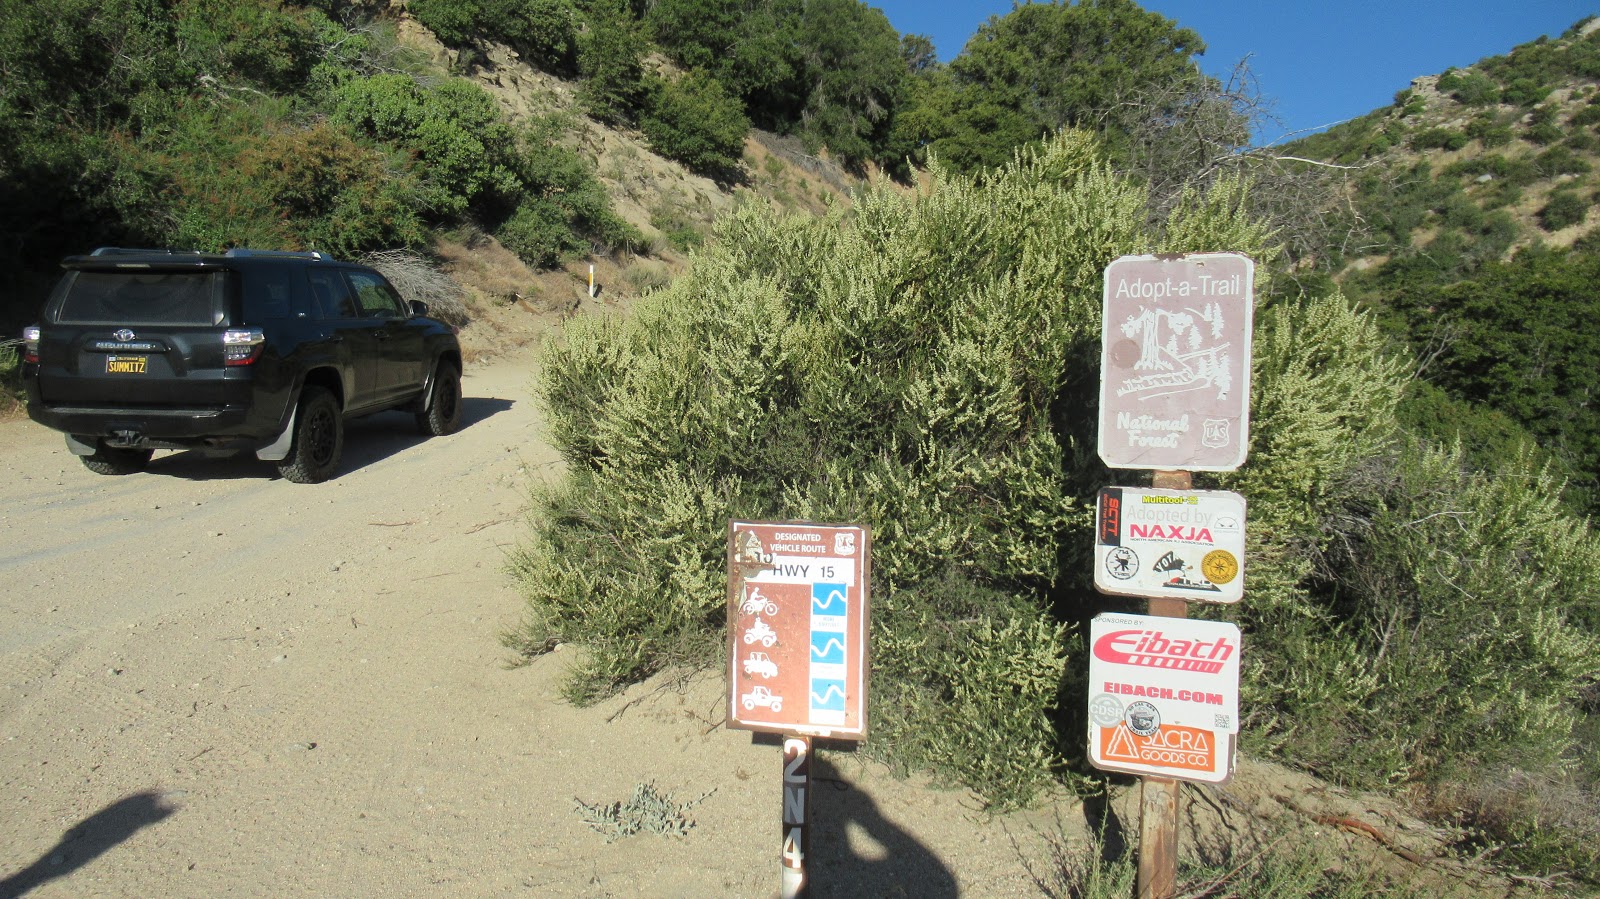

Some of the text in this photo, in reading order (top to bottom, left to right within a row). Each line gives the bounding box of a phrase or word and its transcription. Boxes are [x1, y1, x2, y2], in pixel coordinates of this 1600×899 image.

[1116, 275, 1240, 302] Adopt-a-Trail
[109, 361, 145, 373] SUMMITZ
[1117, 411, 1189, 432] National
[1127, 429, 1179, 448] Forest
[1108, 497, 1119, 537] SCTT
[1126, 505, 1214, 528] Adopted by
[775, 533, 821, 542] DESIGNATED
[1129, 524, 1214, 543] NAXJA
[770, 543, 827, 553] VEHICLE ROUTE
[773, 564, 835, 578] HWY 15
[1094, 616, 1133, 625] SPONSORED
[1093, 630, 1234, 674] Eibach
[1104, 681, 1224, 705] EIBACH.COM
[1141, 750, 1209, 767] GOODS CO.
